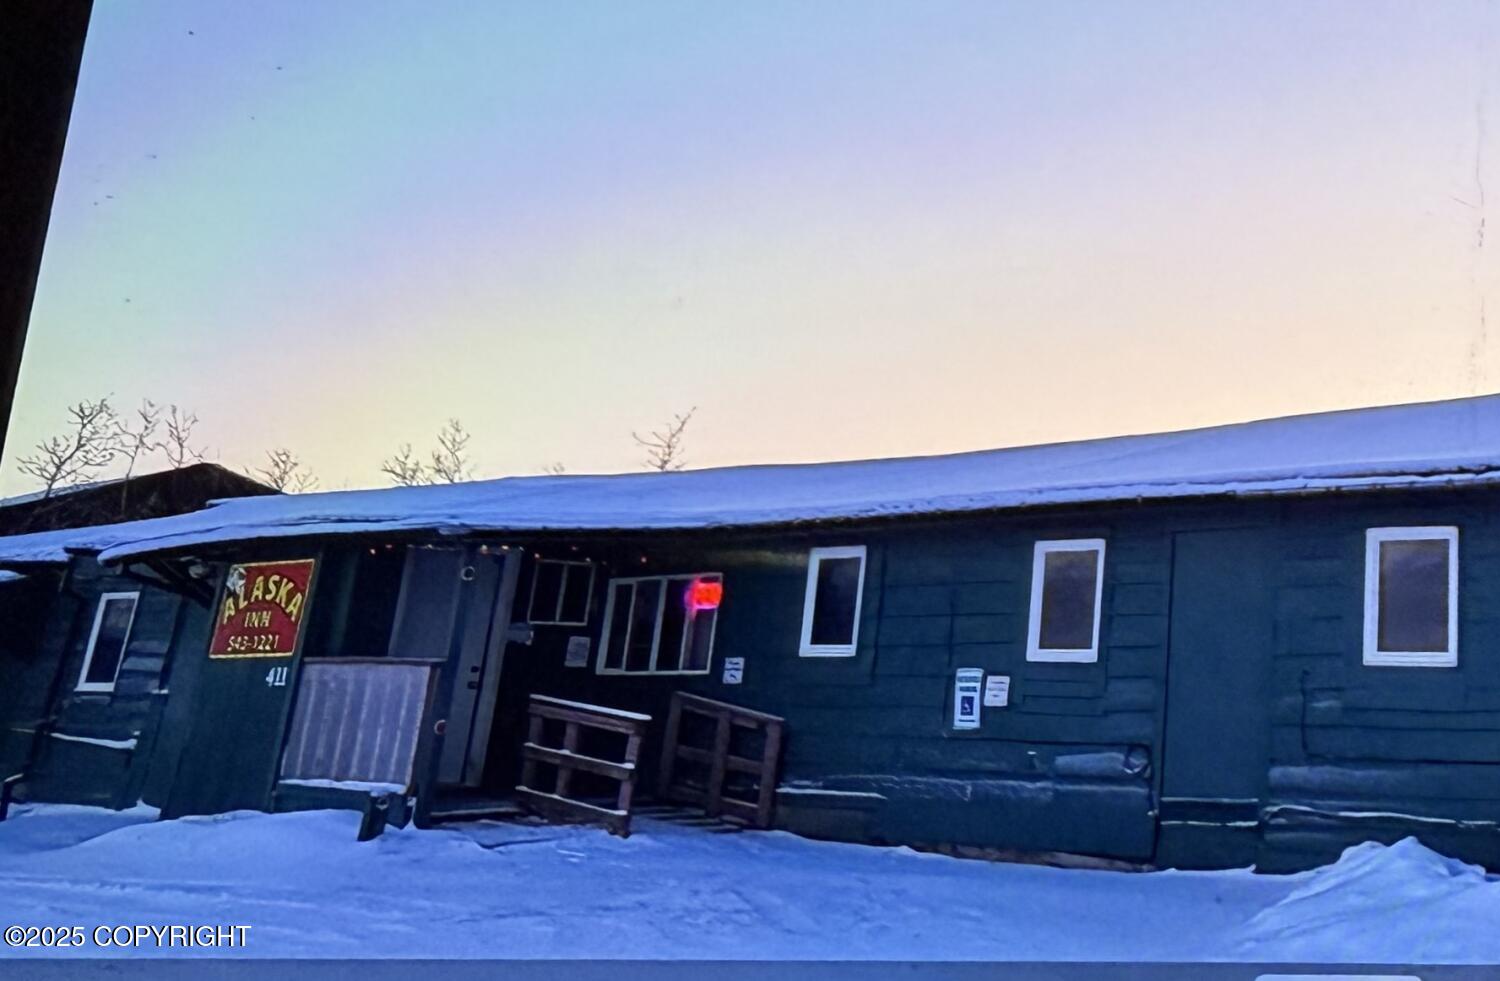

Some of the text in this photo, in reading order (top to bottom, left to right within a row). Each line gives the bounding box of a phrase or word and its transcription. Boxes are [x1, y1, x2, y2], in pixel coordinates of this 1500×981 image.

[223, 574, 303, 625] ALASKA
[244, 610, 272, 628] INN
[227, 634, 279, 651] 543-1221
[265, 667, 288, 687] 411
